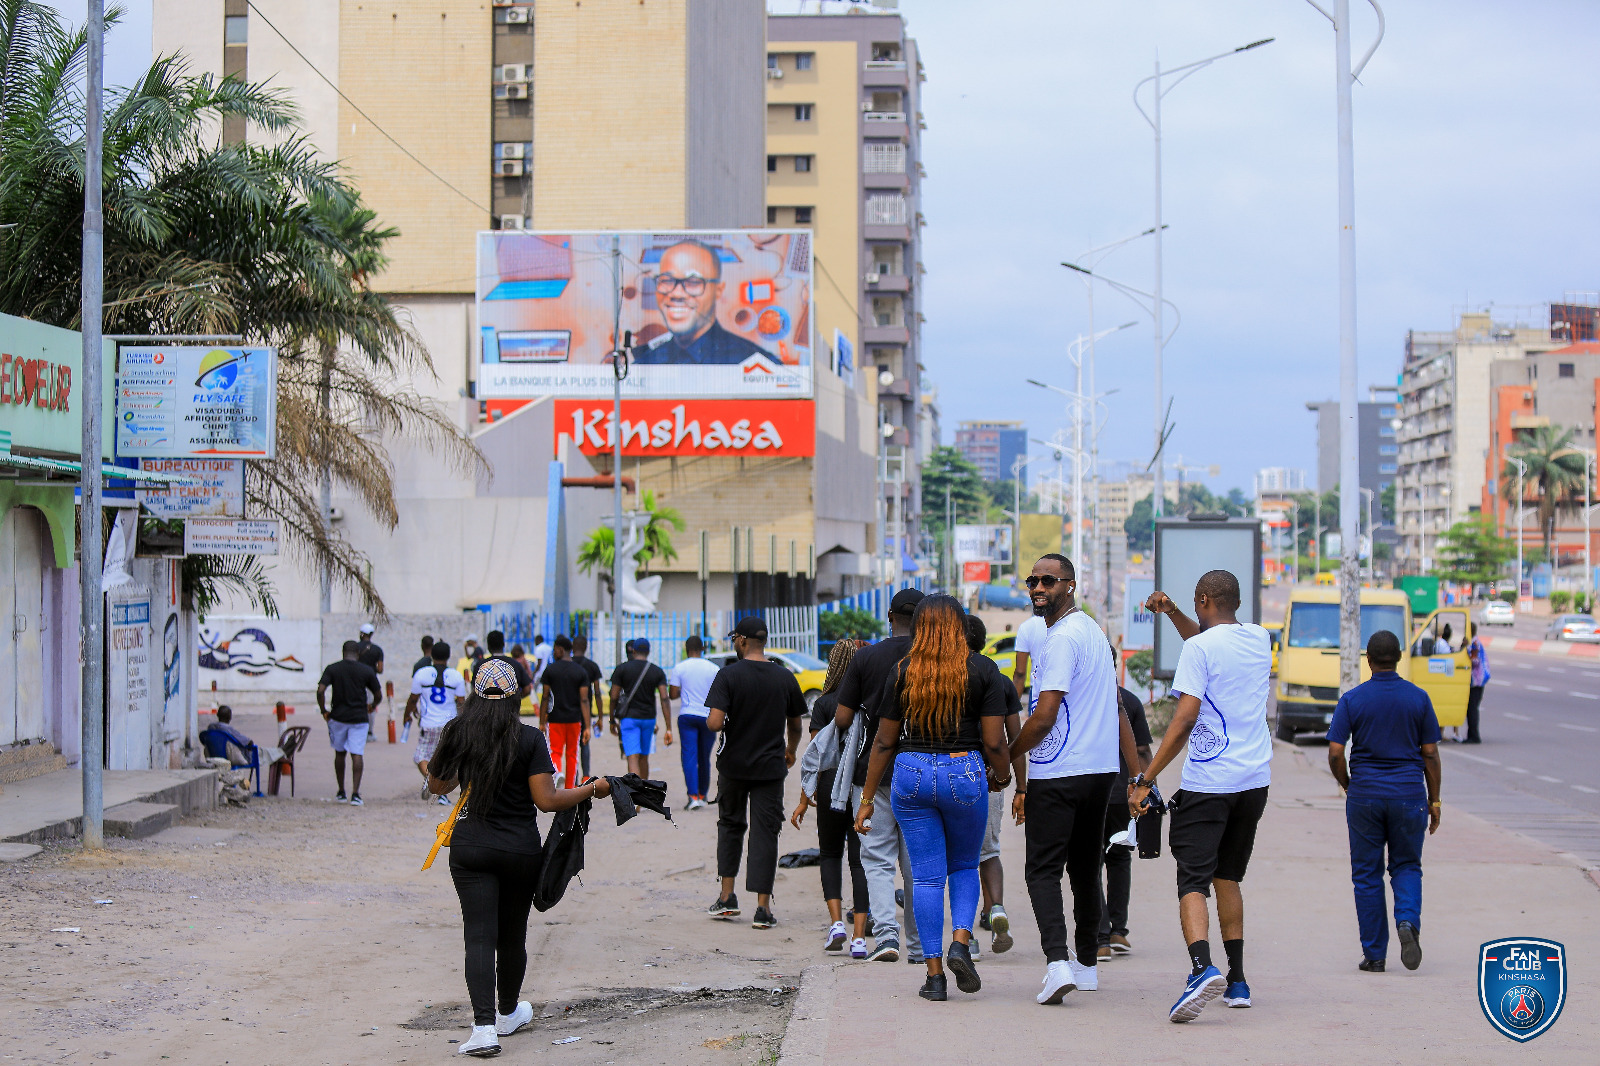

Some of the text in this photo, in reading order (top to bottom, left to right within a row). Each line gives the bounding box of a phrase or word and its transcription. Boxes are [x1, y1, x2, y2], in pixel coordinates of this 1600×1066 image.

[494, 376, 508, 387] LA
[510, 376, 553, 388] BANQUE
[555, 376, 568, 387] LA
[570, 376, 598, 388] PLUS
[193, 394, 246, 403] FLY SAFE
[571, 403, 784, 450] Kinshasa
[143, 460, 235, 472] BUREAUTIQUE
[145, 497, 167, 505] SAISIE
[192, 520, 233, 528] PHOTOCOPIE
[429, 686, 447, 704] 8
